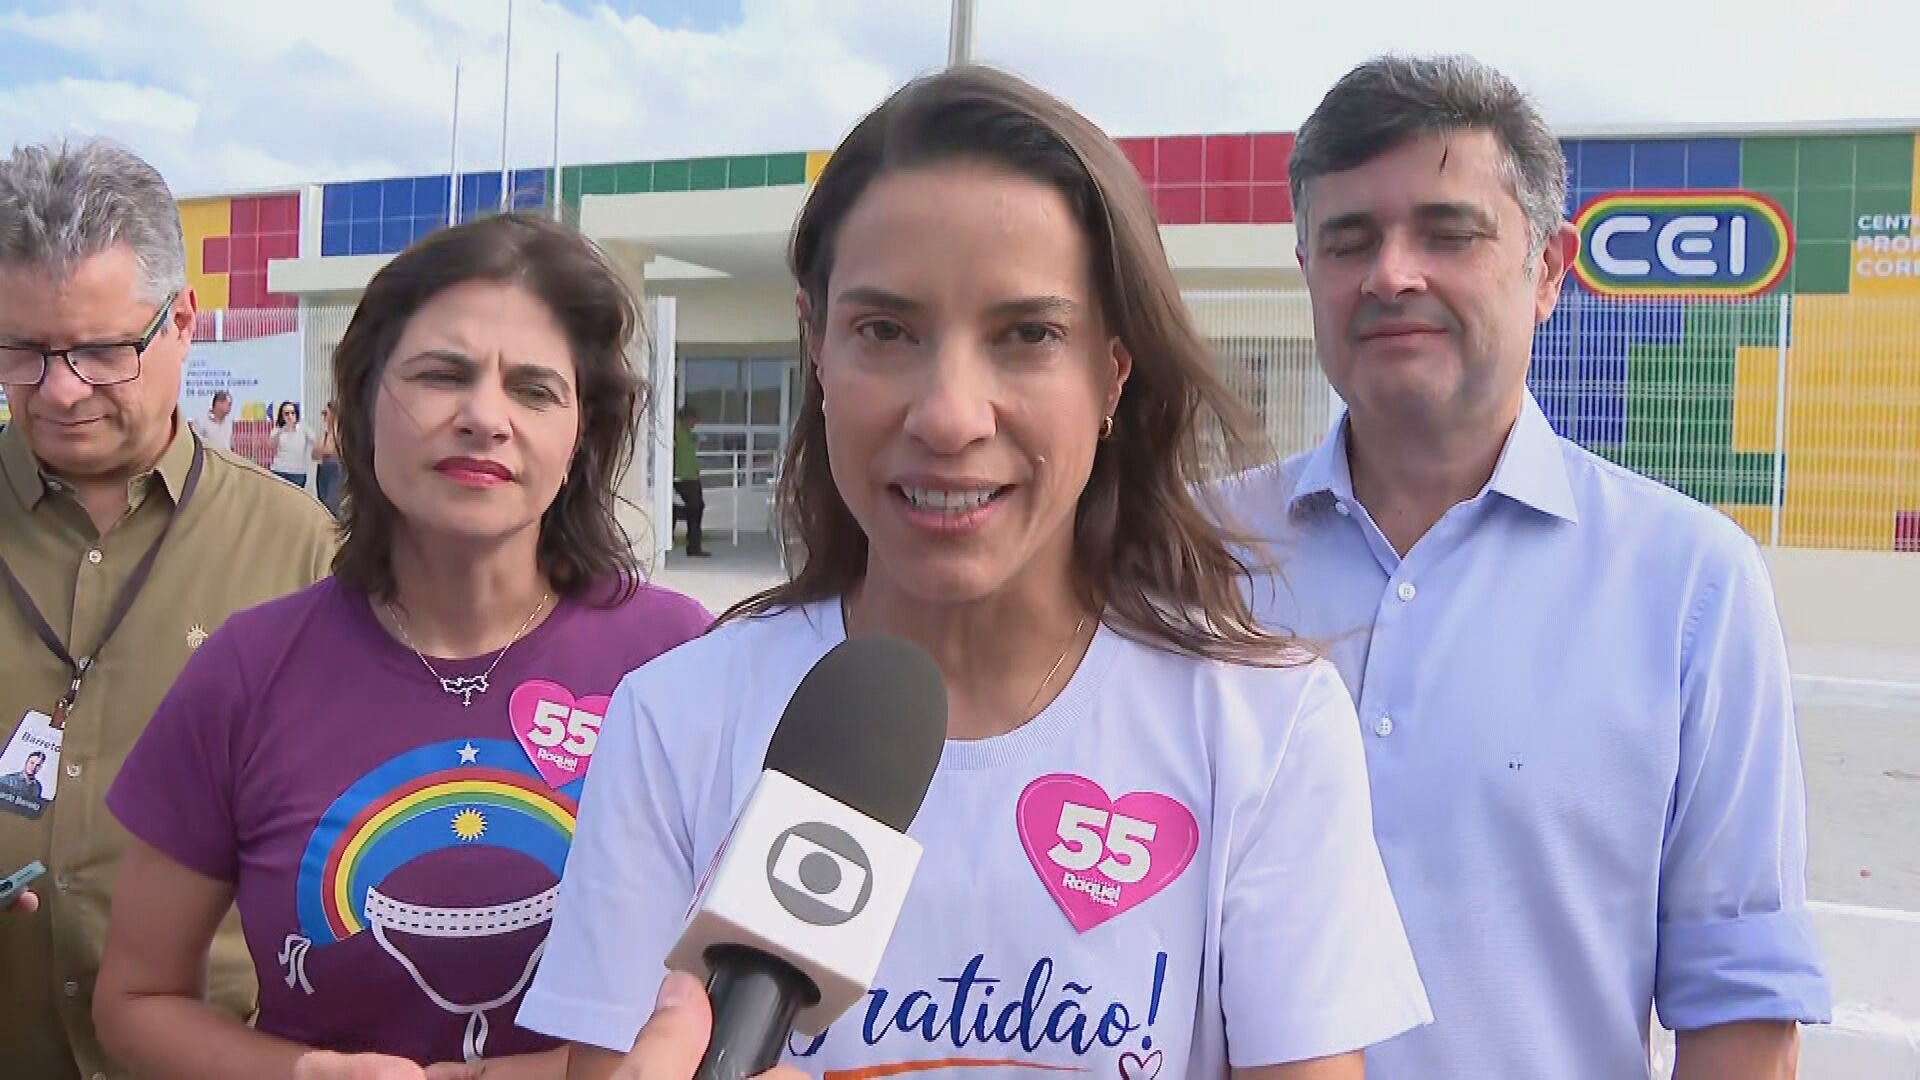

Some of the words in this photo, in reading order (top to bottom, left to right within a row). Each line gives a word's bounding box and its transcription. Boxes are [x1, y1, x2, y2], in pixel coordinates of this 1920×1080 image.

[1590, 215, 1746, 275] CEI
[527, 699, 603, 757] 55
[1046, 800, 1158, 884] 55
[1062, 871, 1121, 902] Raquel
[787, 952, 1167, 1056] ratidão!
